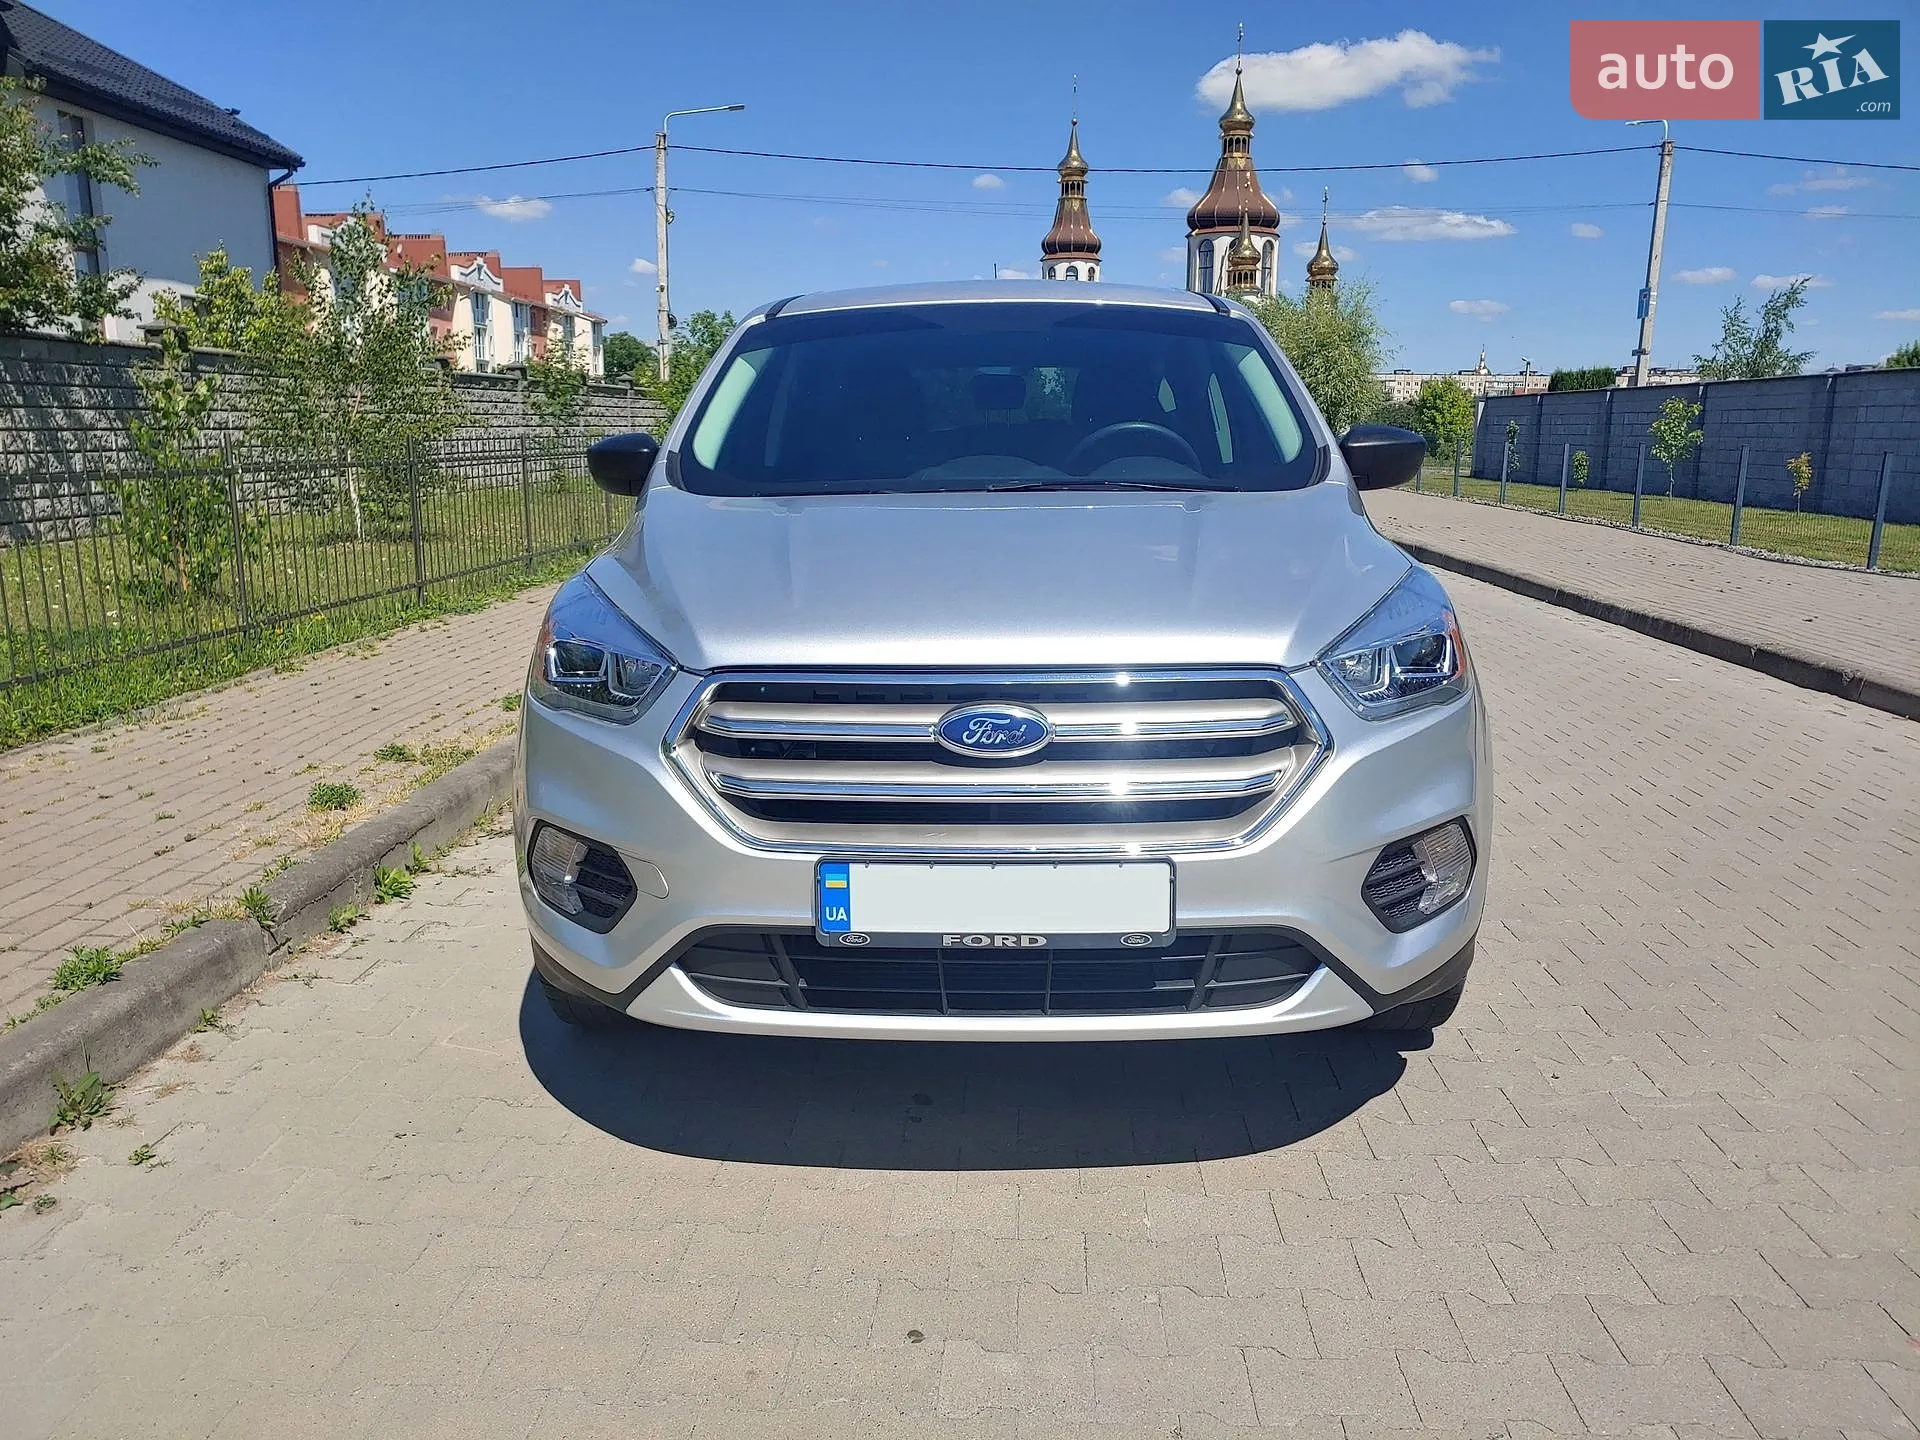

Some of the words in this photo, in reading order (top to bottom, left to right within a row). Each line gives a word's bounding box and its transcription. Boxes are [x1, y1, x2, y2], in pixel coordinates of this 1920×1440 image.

[962, 717, 1027, 745] Ford
[825, 906, 848, 921] UA
[942, 934, 1047, 947] FORD
